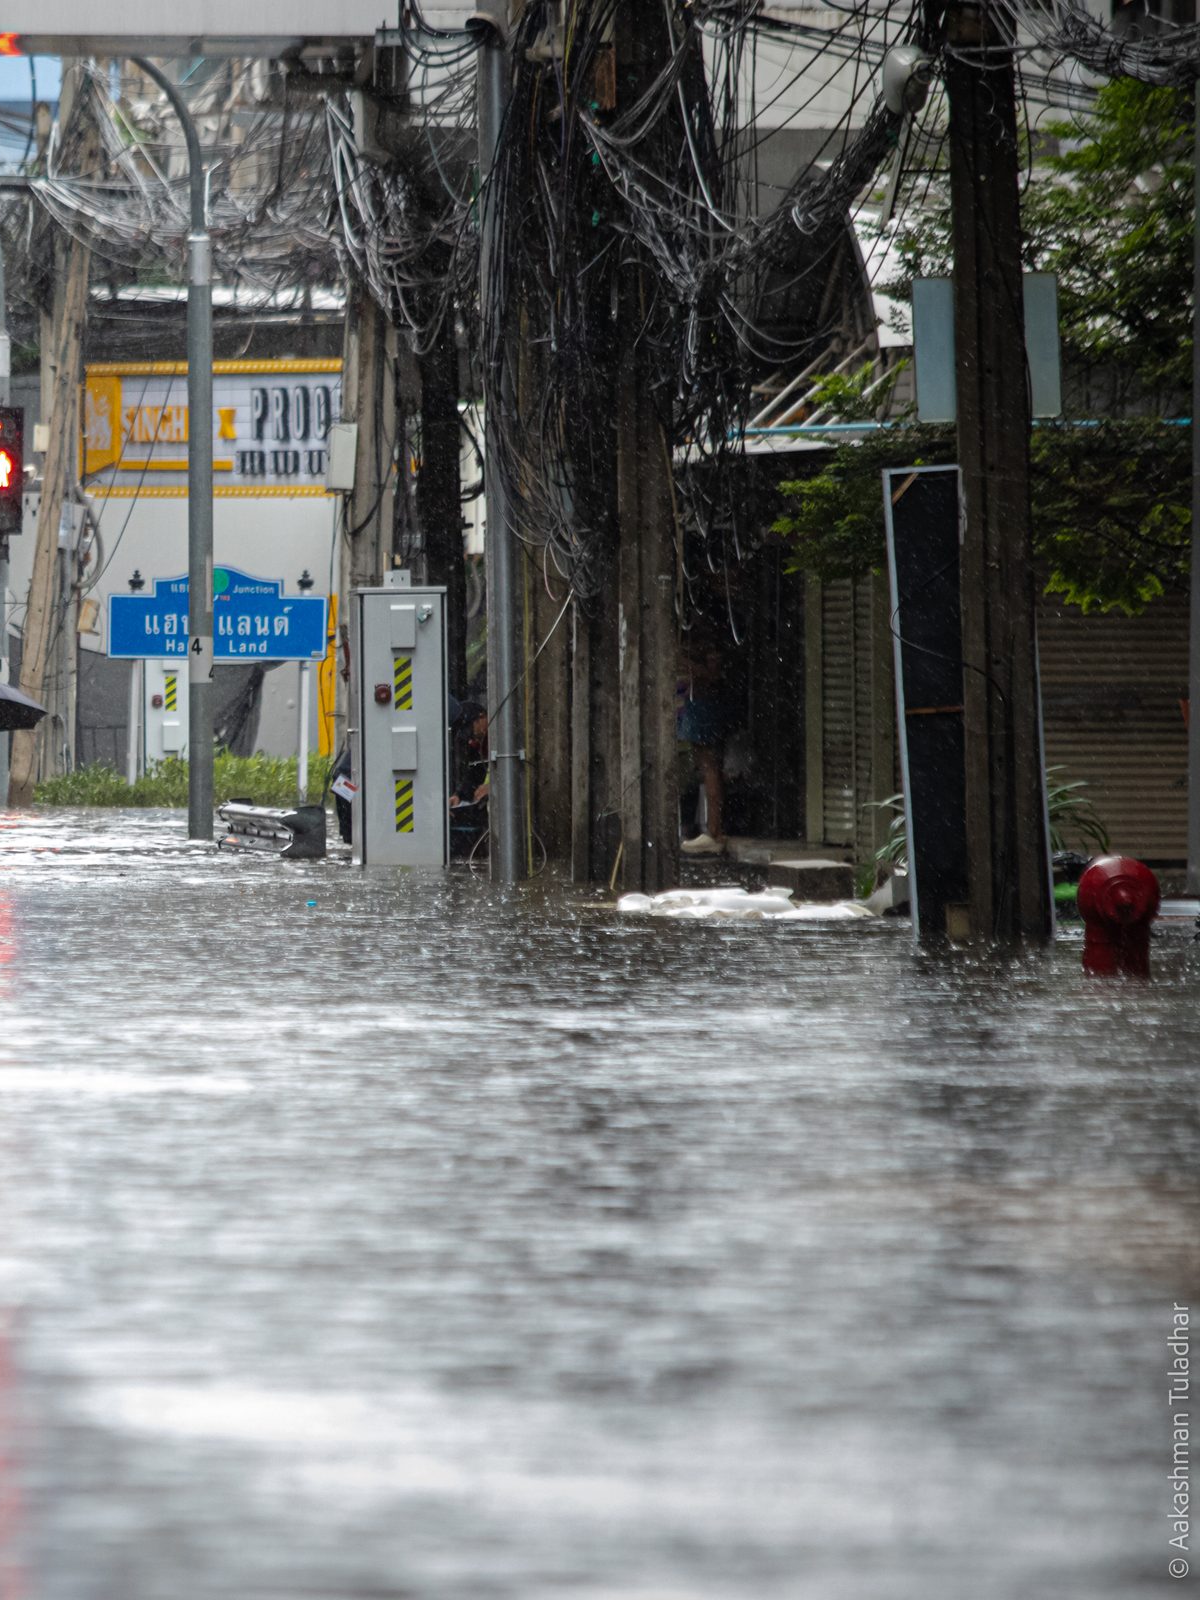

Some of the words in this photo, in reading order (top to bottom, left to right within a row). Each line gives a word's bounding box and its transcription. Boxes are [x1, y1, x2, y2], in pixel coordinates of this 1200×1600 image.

[122, 406, 184, 442] SINGH
[233, 584, 275, 594] Junction
[166, 640, 188, 652] Ha
[229, 640, 267, 653] Land
[191, 637, 202, 655] 4
